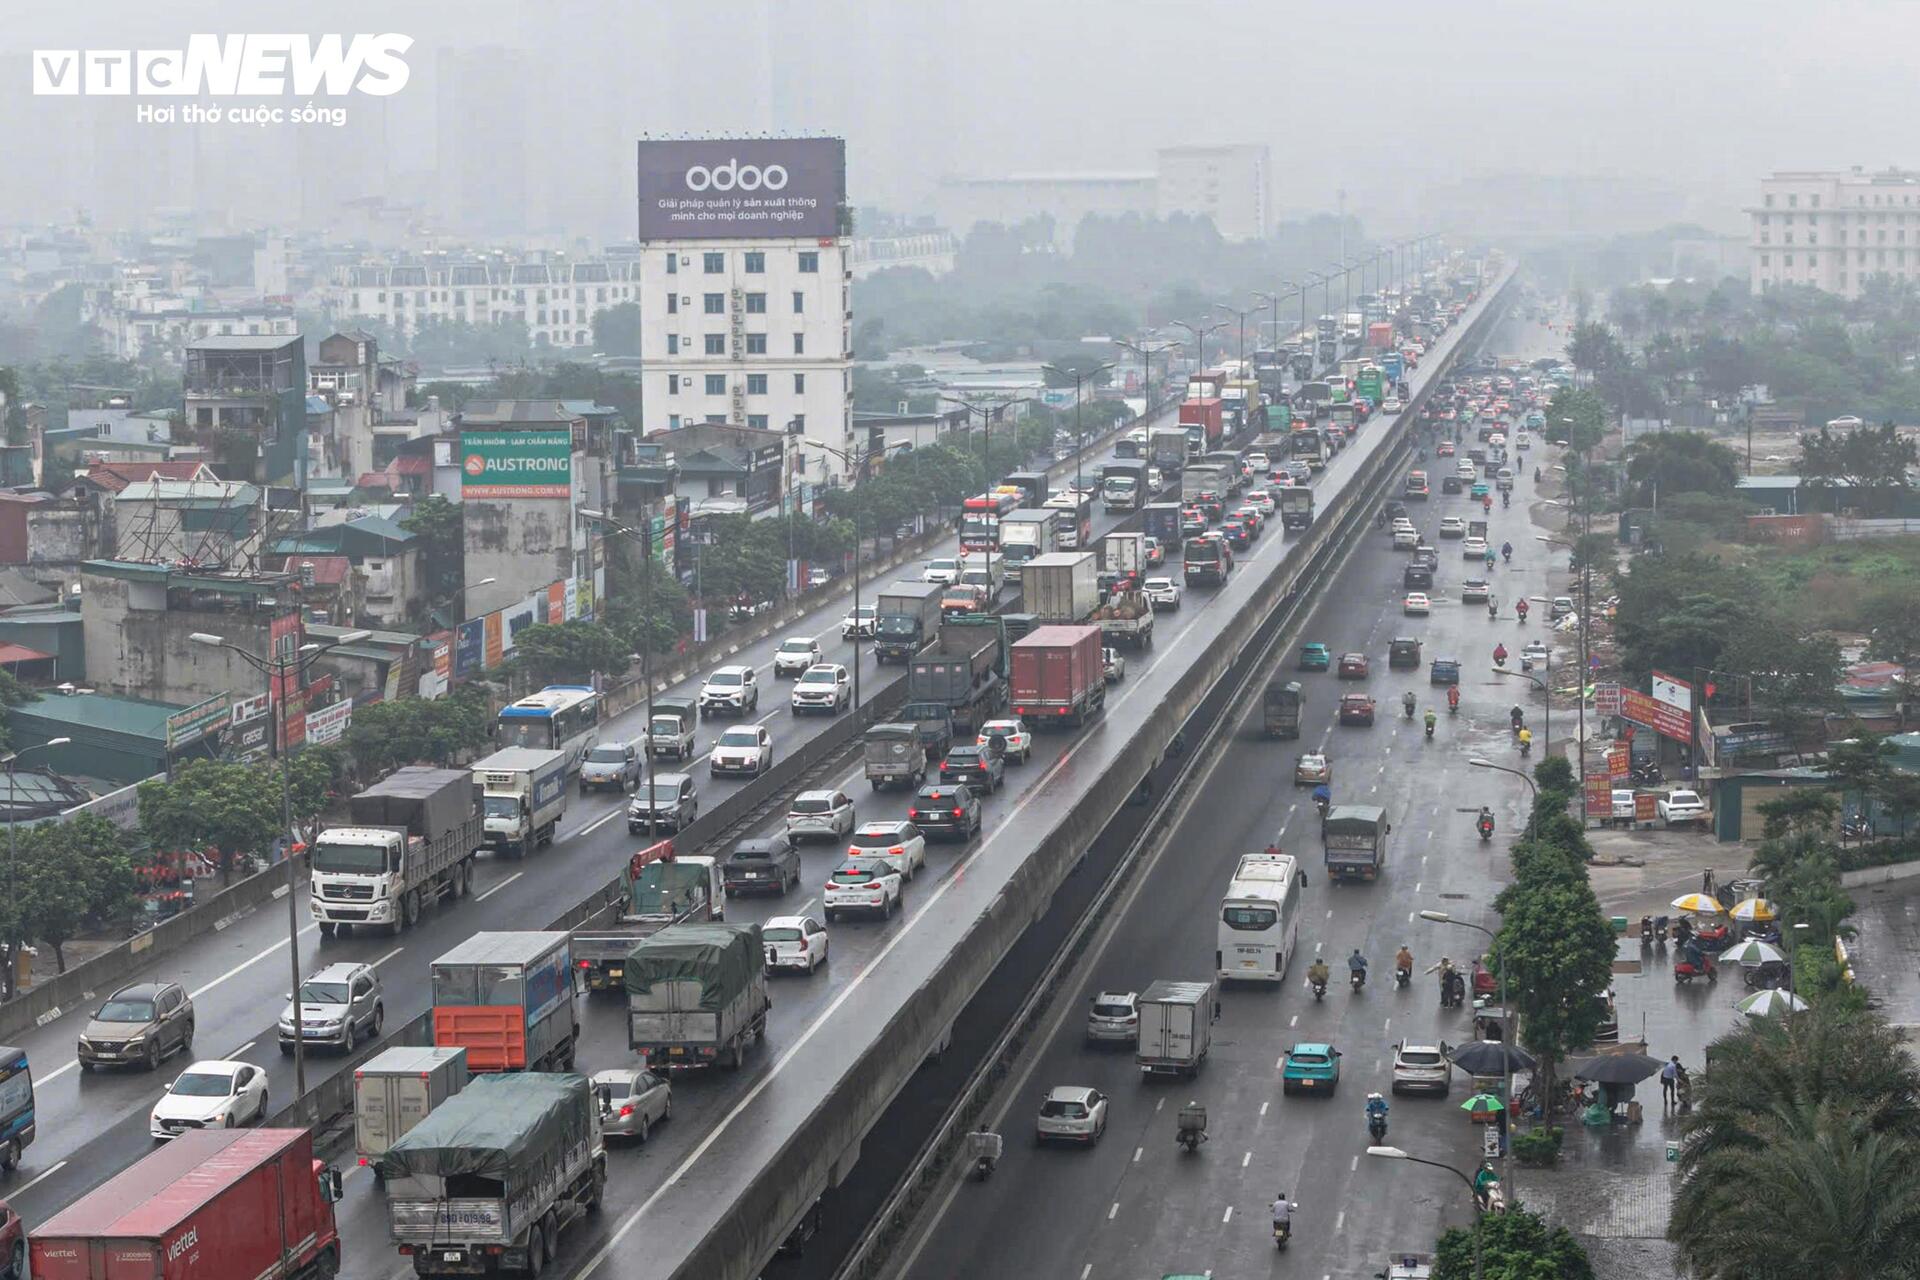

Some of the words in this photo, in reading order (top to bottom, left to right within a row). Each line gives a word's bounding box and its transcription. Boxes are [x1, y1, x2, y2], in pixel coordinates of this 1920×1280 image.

[686, 158, 788, 191] odoo
[658, 199, 677, 209] Giải
[680, 199, 704, 210] pháp
[706, 199, 731, 210] quản
[732, 199, 742, 210] lý
[744, 199, 762, 208] sản
[764, 198, 786, 208] xuất
[788, 198, 817, 211] thông
[671, 211, 695, 220] minh
[697, 211, 716, 220] cho
[718, 211, 735, 221] mọi
[738, 211, 768, 220] doanh
[770, 211, 804, 221] nghiệp
[485, 458, 568, 471] AUSTRONG
[167, 1226, 198, 1262] viettel
[43, 1248, 77, 1258] viettel
